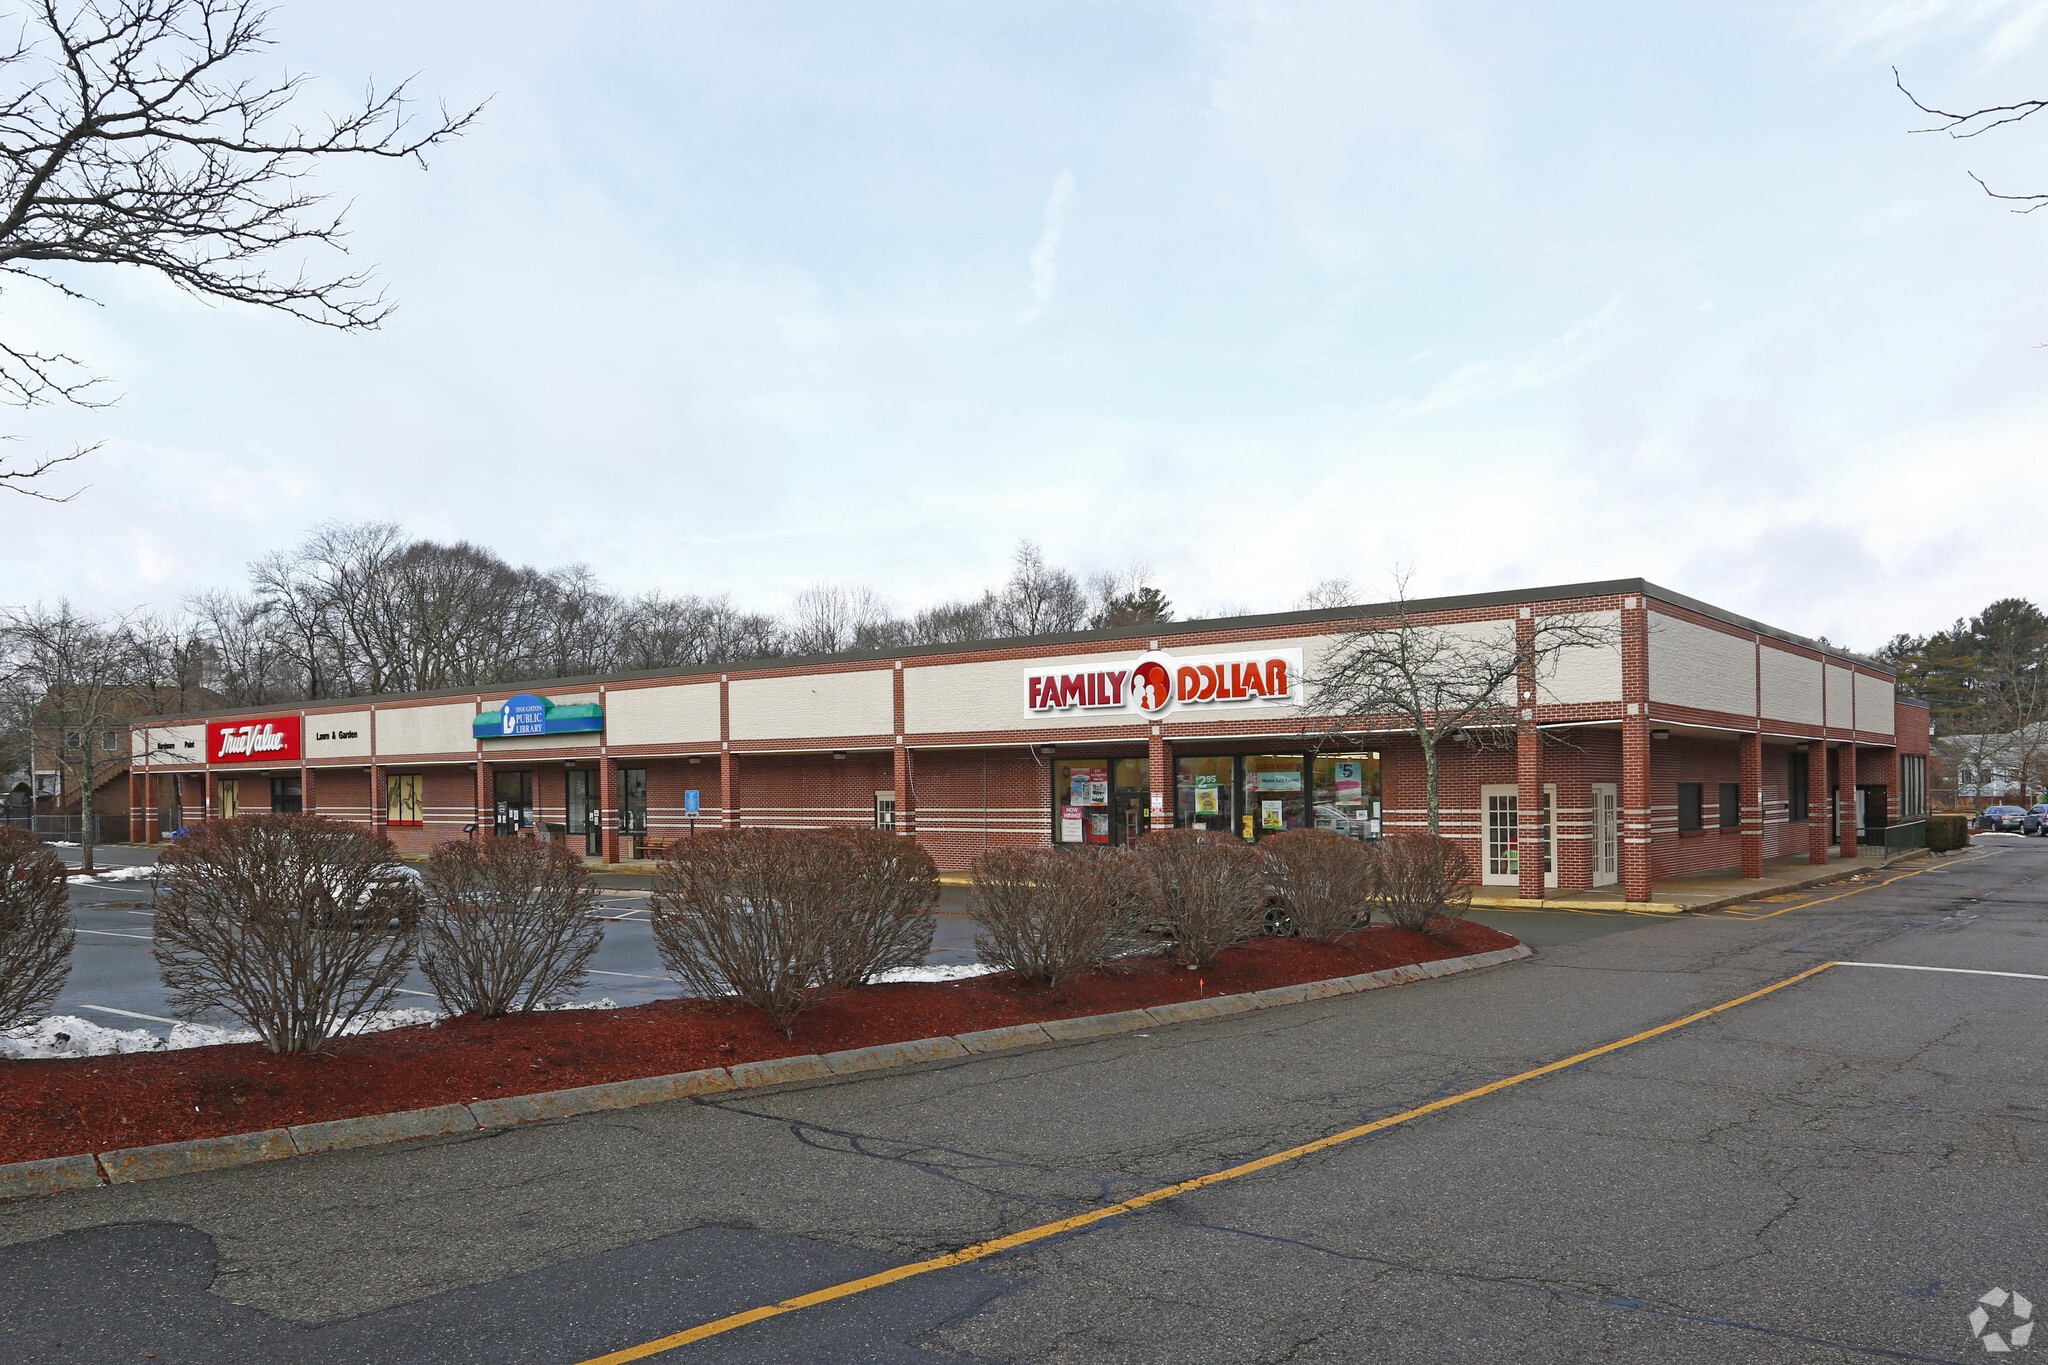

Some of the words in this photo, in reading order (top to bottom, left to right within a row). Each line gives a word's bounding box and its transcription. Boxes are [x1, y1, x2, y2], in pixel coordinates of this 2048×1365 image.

[1028, 670, 1128, 709] FAMILY
[1177, 658, 1288, 702] DOLLAR
[516, 713, 542, 724] PUBLIC
[516, 724, 542, 733] LIBRARY
[316, 732, 330, 741] Lawn
[332, 731, 336, 740] &
[338, 730, 358, 740] Garden
[184, 741, 195, 749] Paint
